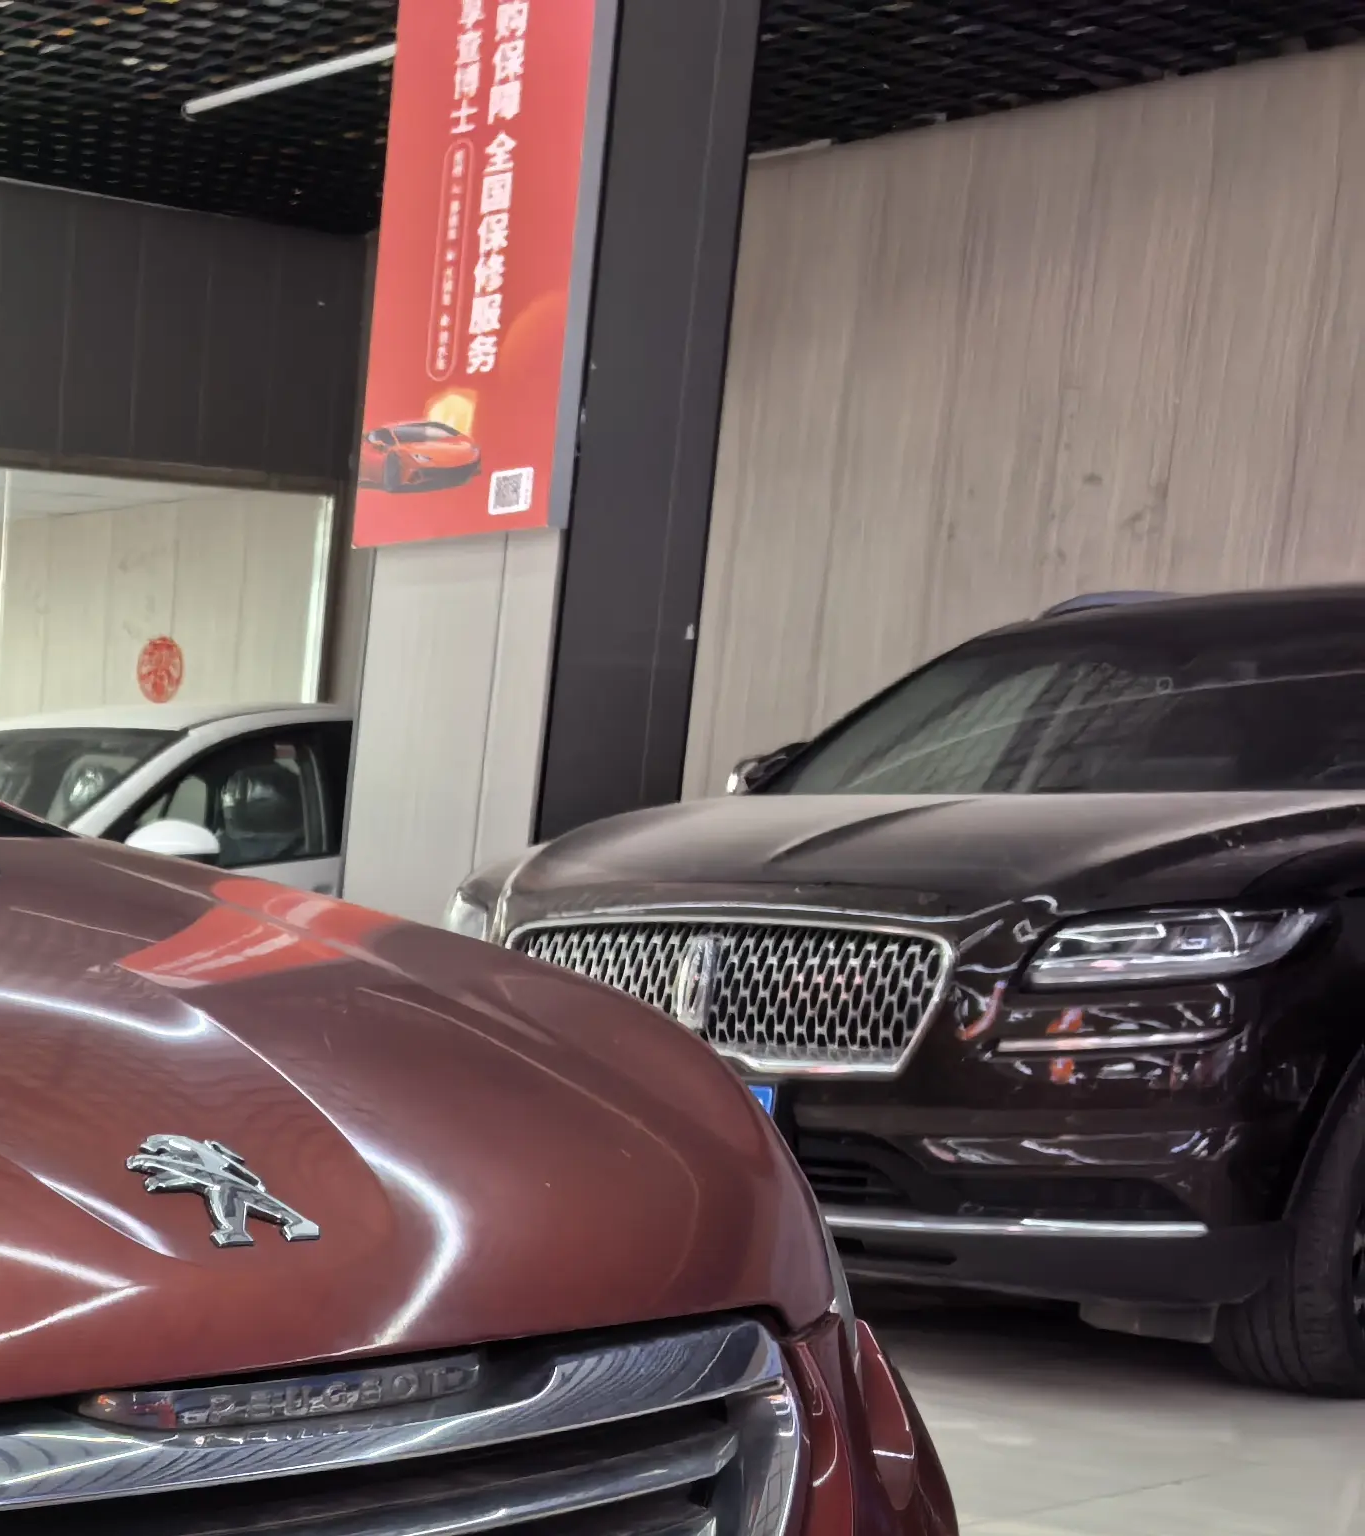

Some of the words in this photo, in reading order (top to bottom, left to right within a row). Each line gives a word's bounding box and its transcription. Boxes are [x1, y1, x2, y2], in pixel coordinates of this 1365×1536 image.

[466, 130, 517, 374] 全国保修服务
